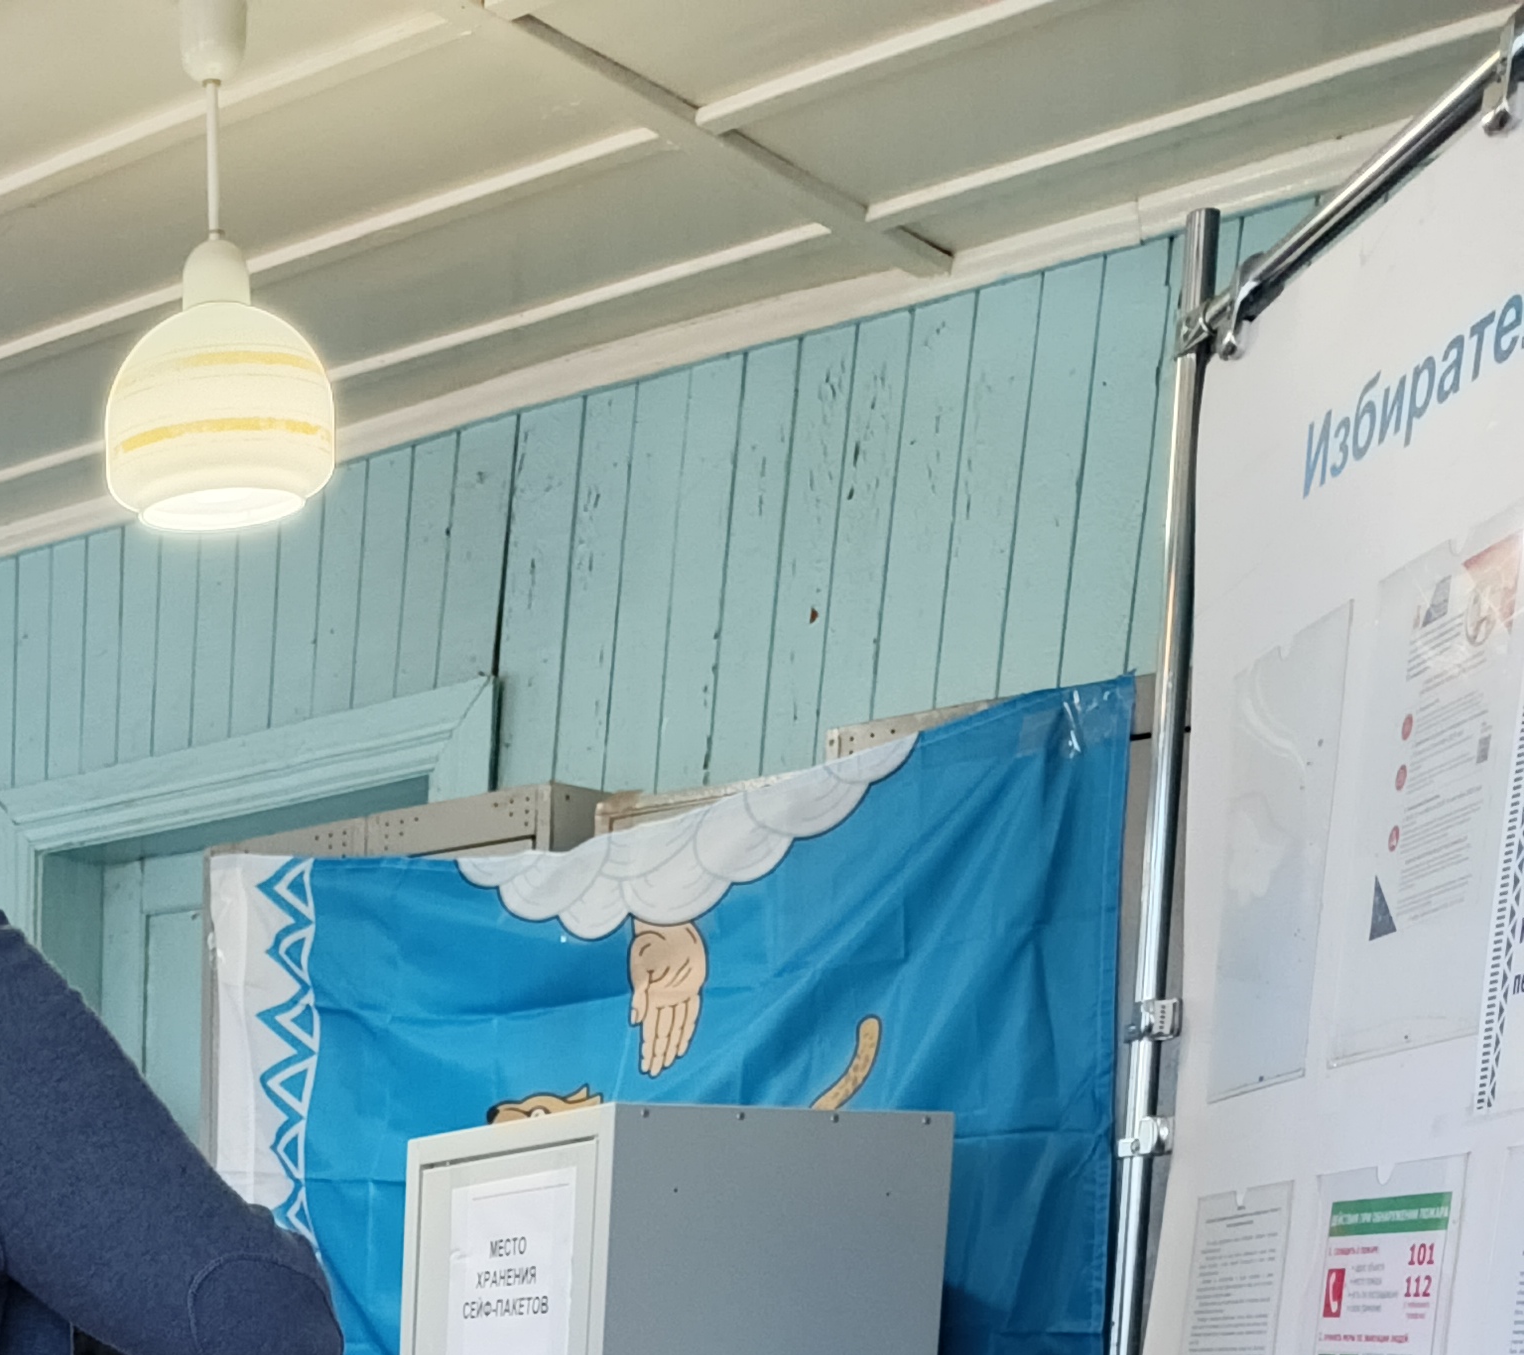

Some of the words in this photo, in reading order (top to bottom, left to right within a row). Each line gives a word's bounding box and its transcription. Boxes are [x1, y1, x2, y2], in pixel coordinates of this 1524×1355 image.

[1302, 293, 1524, 500] Избирате
[489, 1236, 527, 1259] МЕСТО
[1407, 1242, 1435, 1266] 101
[475, 1265, 537, 1289] ХРАНЕНИЯ
[1403, 1274, 1433, 1298] 112
[462, 1295, 549, 1320] СЕЙФ-ПАКЕТОВ
